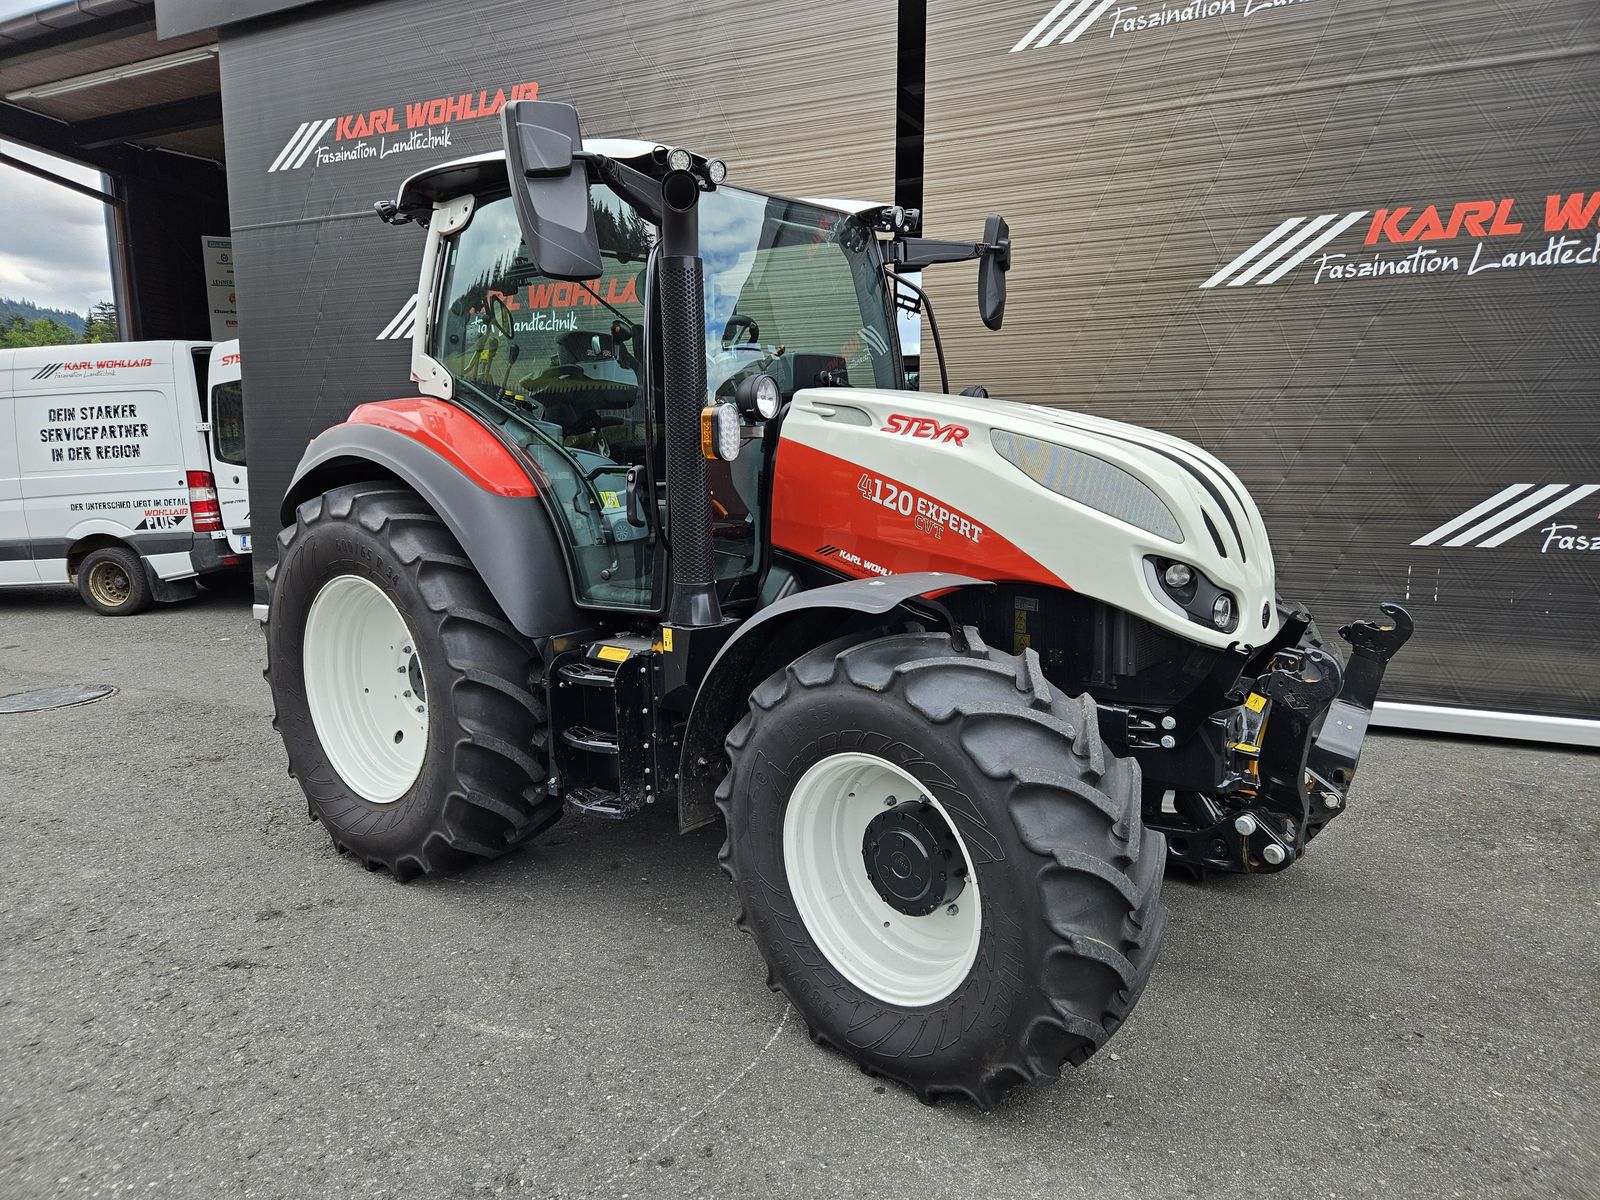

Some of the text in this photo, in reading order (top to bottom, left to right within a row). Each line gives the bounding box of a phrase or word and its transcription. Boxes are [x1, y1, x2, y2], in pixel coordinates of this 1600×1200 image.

[1108, 0, 1235, 38] Faszination
[335, 107, 399, 141] KARL
[314, 126, 452, 167] Faszination Landtechnik
[1364, 191, 1600, 246] KARL W
[1312, 247, 1459, 285] Faszination
[499, 310, 578, 337] andtechnik
[64, 360, 94, 371] KARL
[48, 404, 137, 422] DEIN STARKER
[40, 423, 149, 443] SERVICEPARTNER
[880, 413, 970, 448] STEYR
[51, 444, 141, 462] IN DER REGION
[70, 498, 188, 511] DER UNTERSCHIED LIEGT IM DETAIL
[856, 473, 983, 544] 4120 EXPERT
[145, 516, 179, 529] PLUS
[914, 514, 945, 541] CVT
[838, 549, 862, 566] KARL
[863, 559, 898, 577] WOHL
